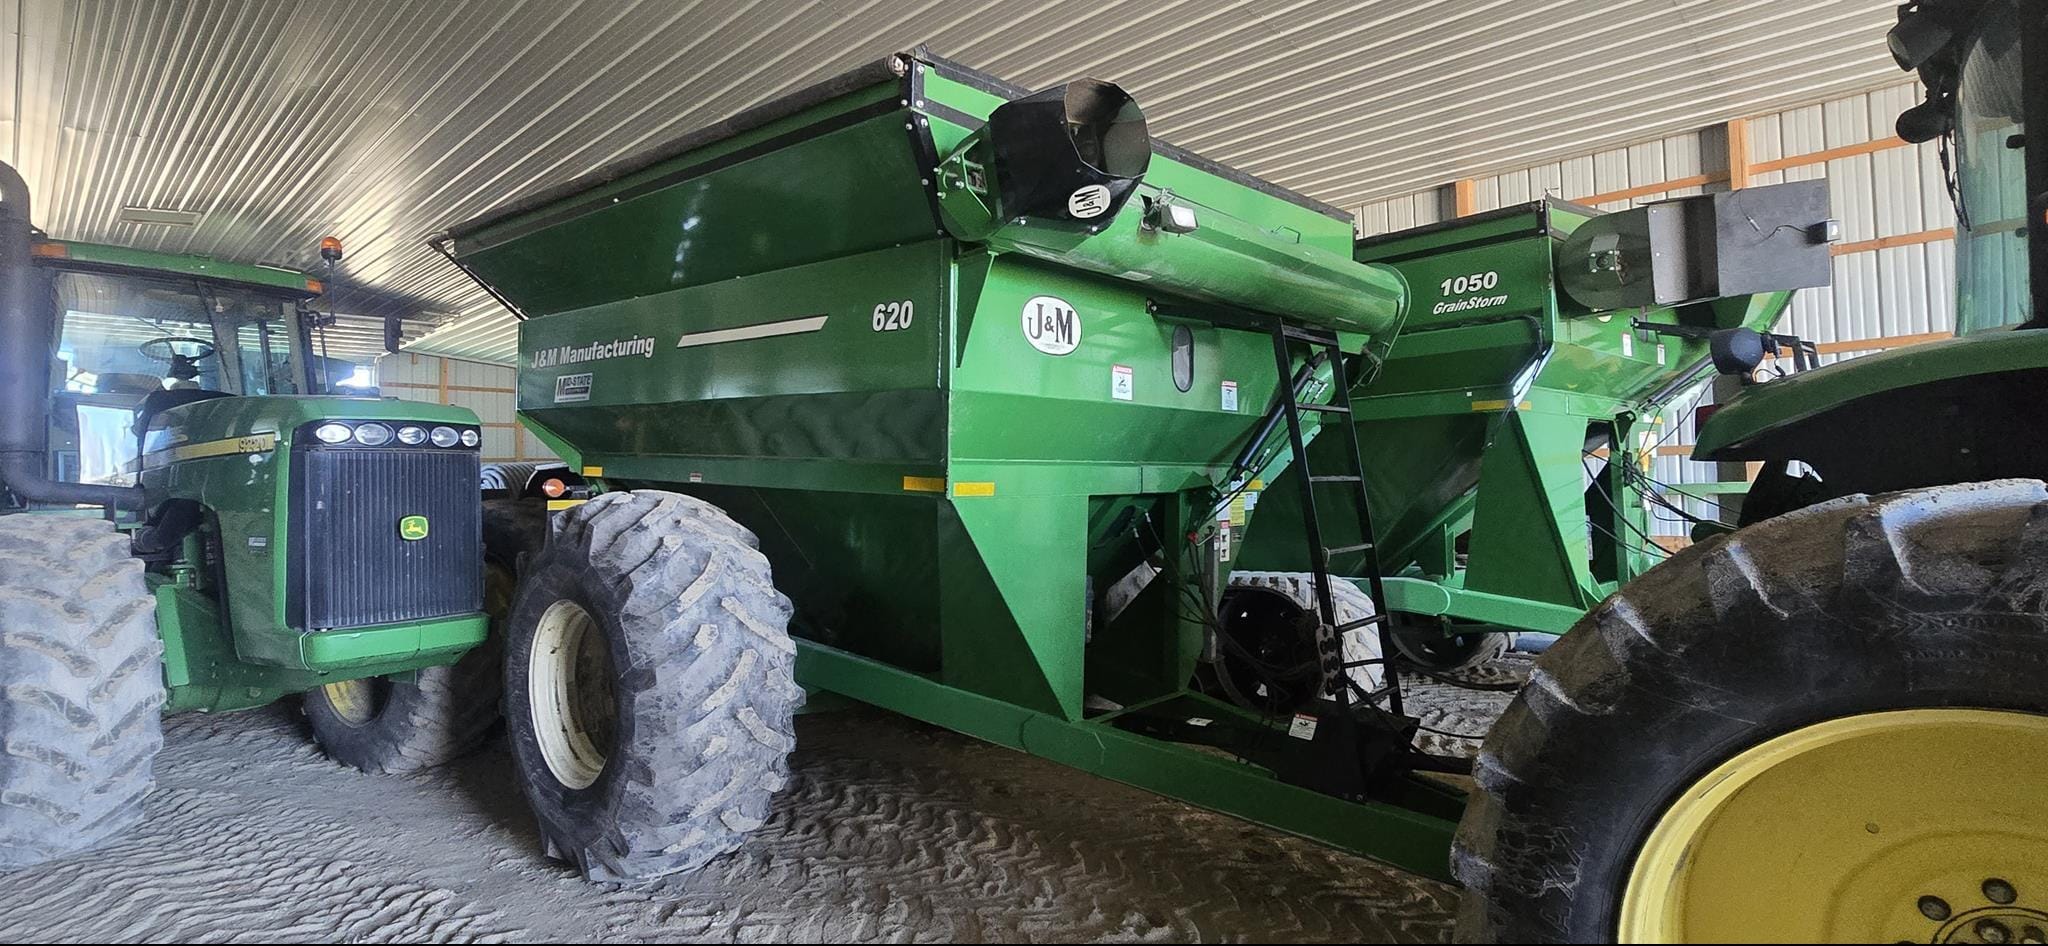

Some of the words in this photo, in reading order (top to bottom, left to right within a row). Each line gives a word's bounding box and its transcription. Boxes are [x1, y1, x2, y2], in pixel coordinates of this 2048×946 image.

[1075, 188, 1101, 215] J&M
[1441, 271, 1498, 296] 1050
[872, 300, 914, 331] 620
[1433, 295, 1508, 314] GrainStorm
[1027, 303, 1074, 345] J&M
[531, 348, 558, 368] J&M
[560, 335, 655, 365] Manufacturing
